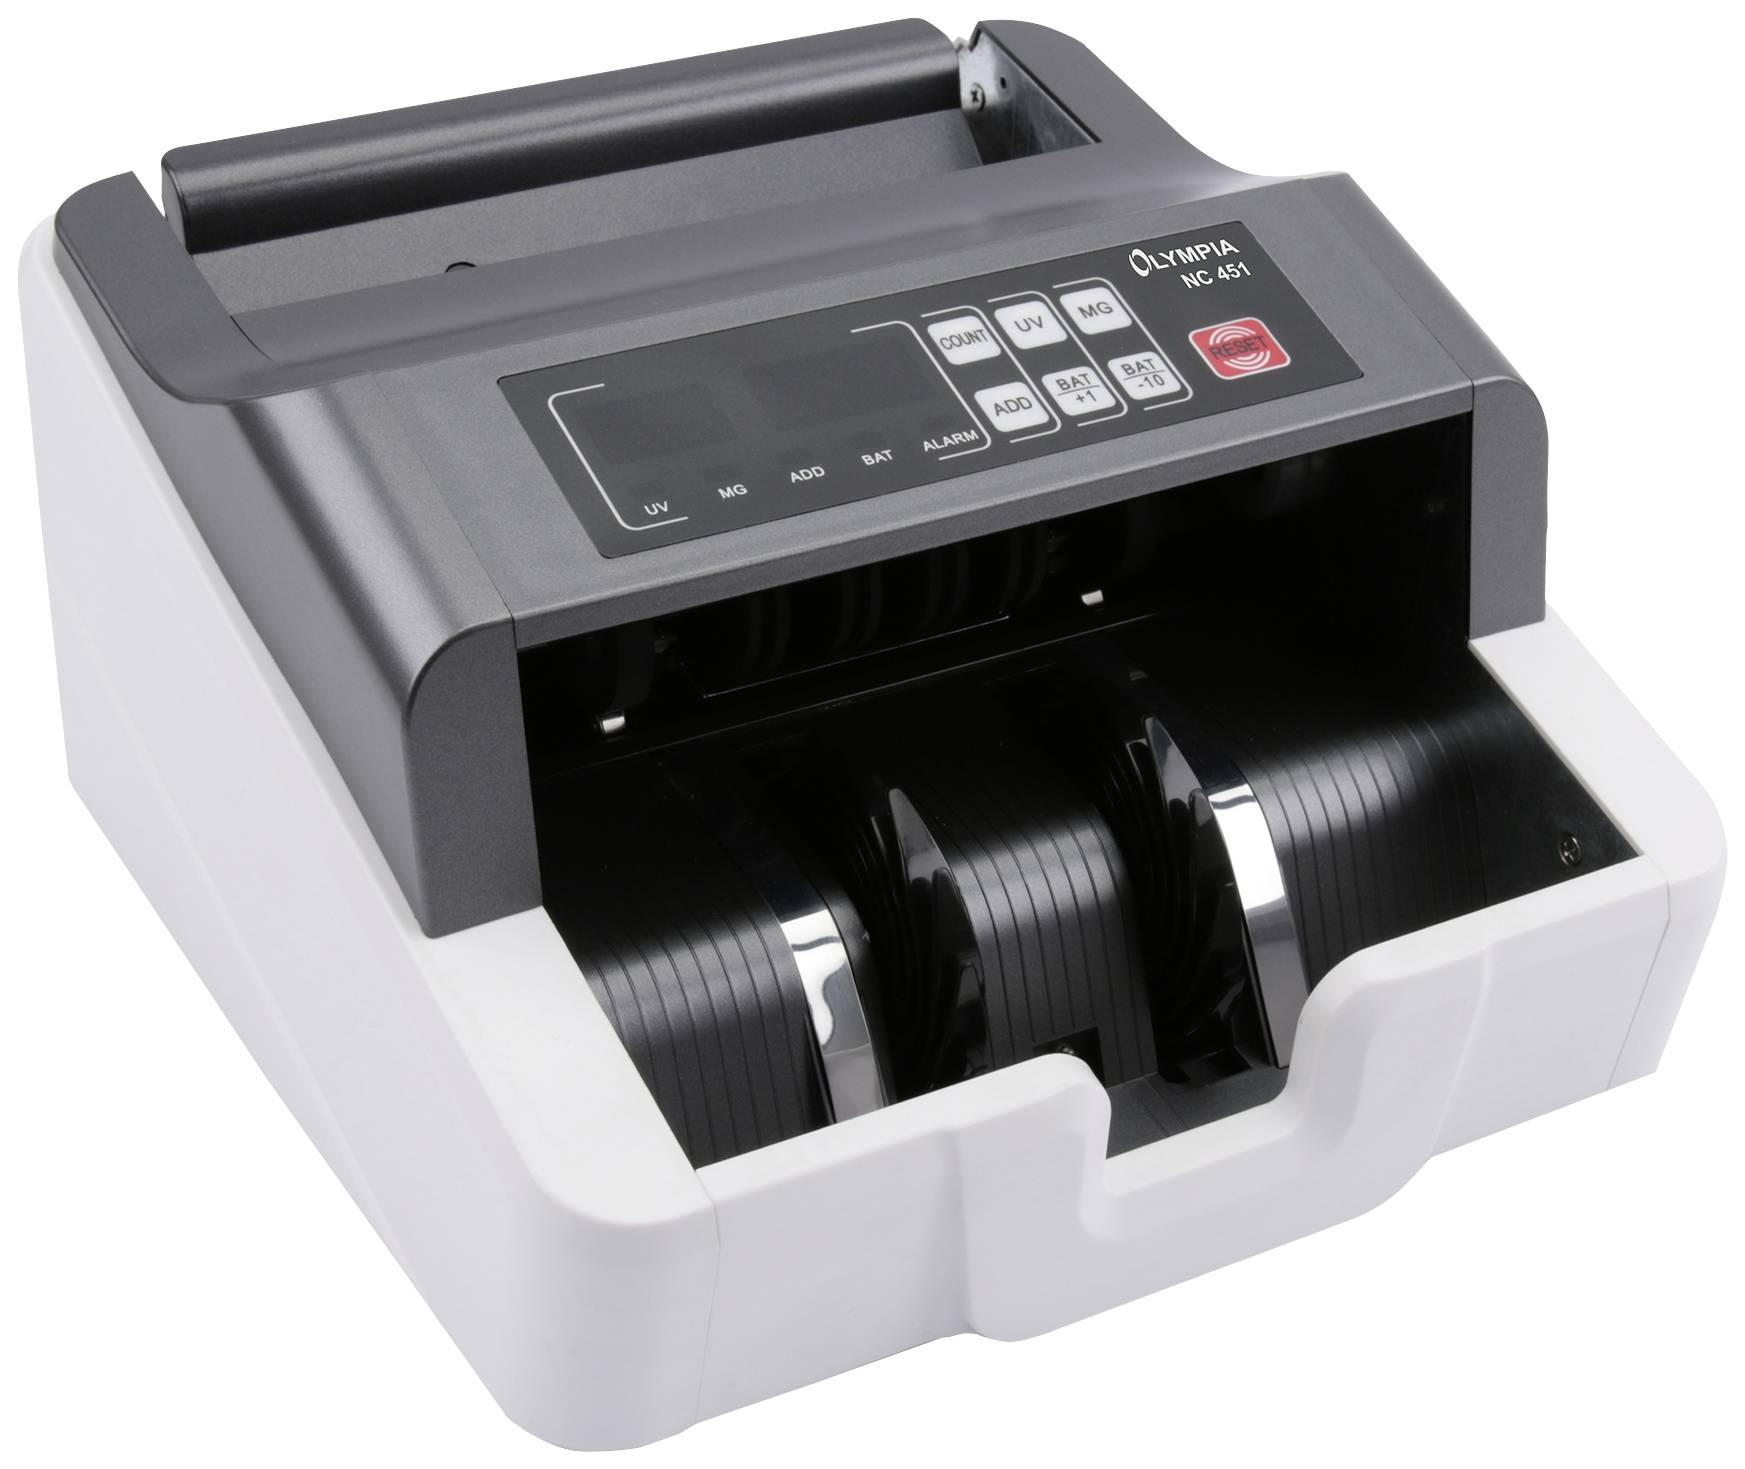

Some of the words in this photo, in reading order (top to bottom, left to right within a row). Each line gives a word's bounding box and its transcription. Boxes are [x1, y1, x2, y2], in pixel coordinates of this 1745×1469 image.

[1128, 238, 1240, 278] OLYMPIA
[1181, 268, 1214, 289] NC
[1217, 261, 1252, 282] 451
[1077, 301, 1114, 319] MG
[1015, 315, 1045, 333] UV
[939, 328, 989, 351] COUNT
[1208, 335, 1268, 360] RESET
[1120, 358, 1156, 377] BAT
[1056, 372, 1093, 391] BAT
[1137, 373, 1166, 389] -10
[1074, 389, 1098, 404] +1
[993, 396, 1034, 417] ADD
[923, 429, 980, 452] ALARM
[861, 449, 894, 466] BAT
[790, 465, 825, 483] ADD
[717, 483, 749, 500] MG
[643, 500, 669, 516] UV
